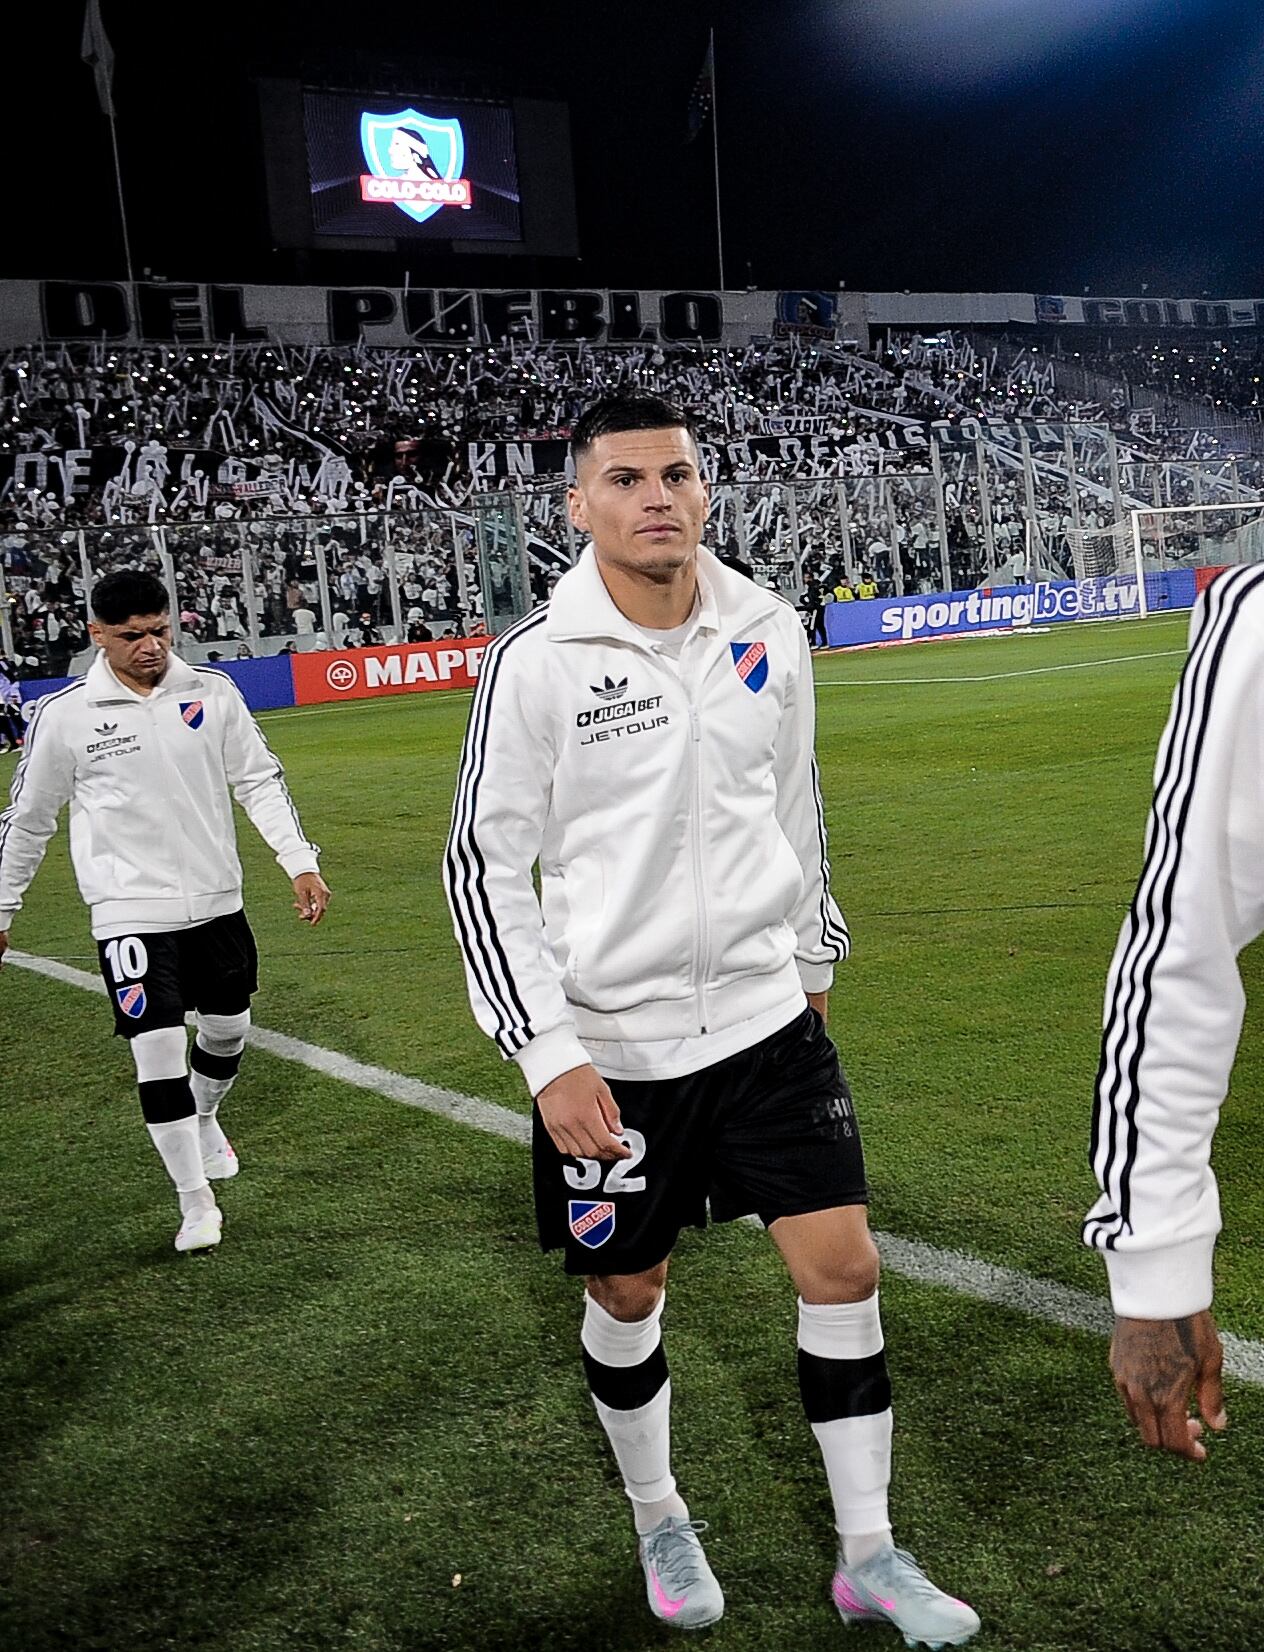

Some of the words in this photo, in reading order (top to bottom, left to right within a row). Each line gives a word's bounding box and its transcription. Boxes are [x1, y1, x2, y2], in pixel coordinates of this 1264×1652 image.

[367, 180, 467, 201] COLO-COLO
[40, 281, 269, 343] DEL
[328, 288, 723, 343] PUEBLO
[881, 581, 1139, 639] sportingbet.tv
[364, 647, 486, 687] MAPF
[581, 715, 669, 745] JETOUR
[105, 936, 148, 983] 10
